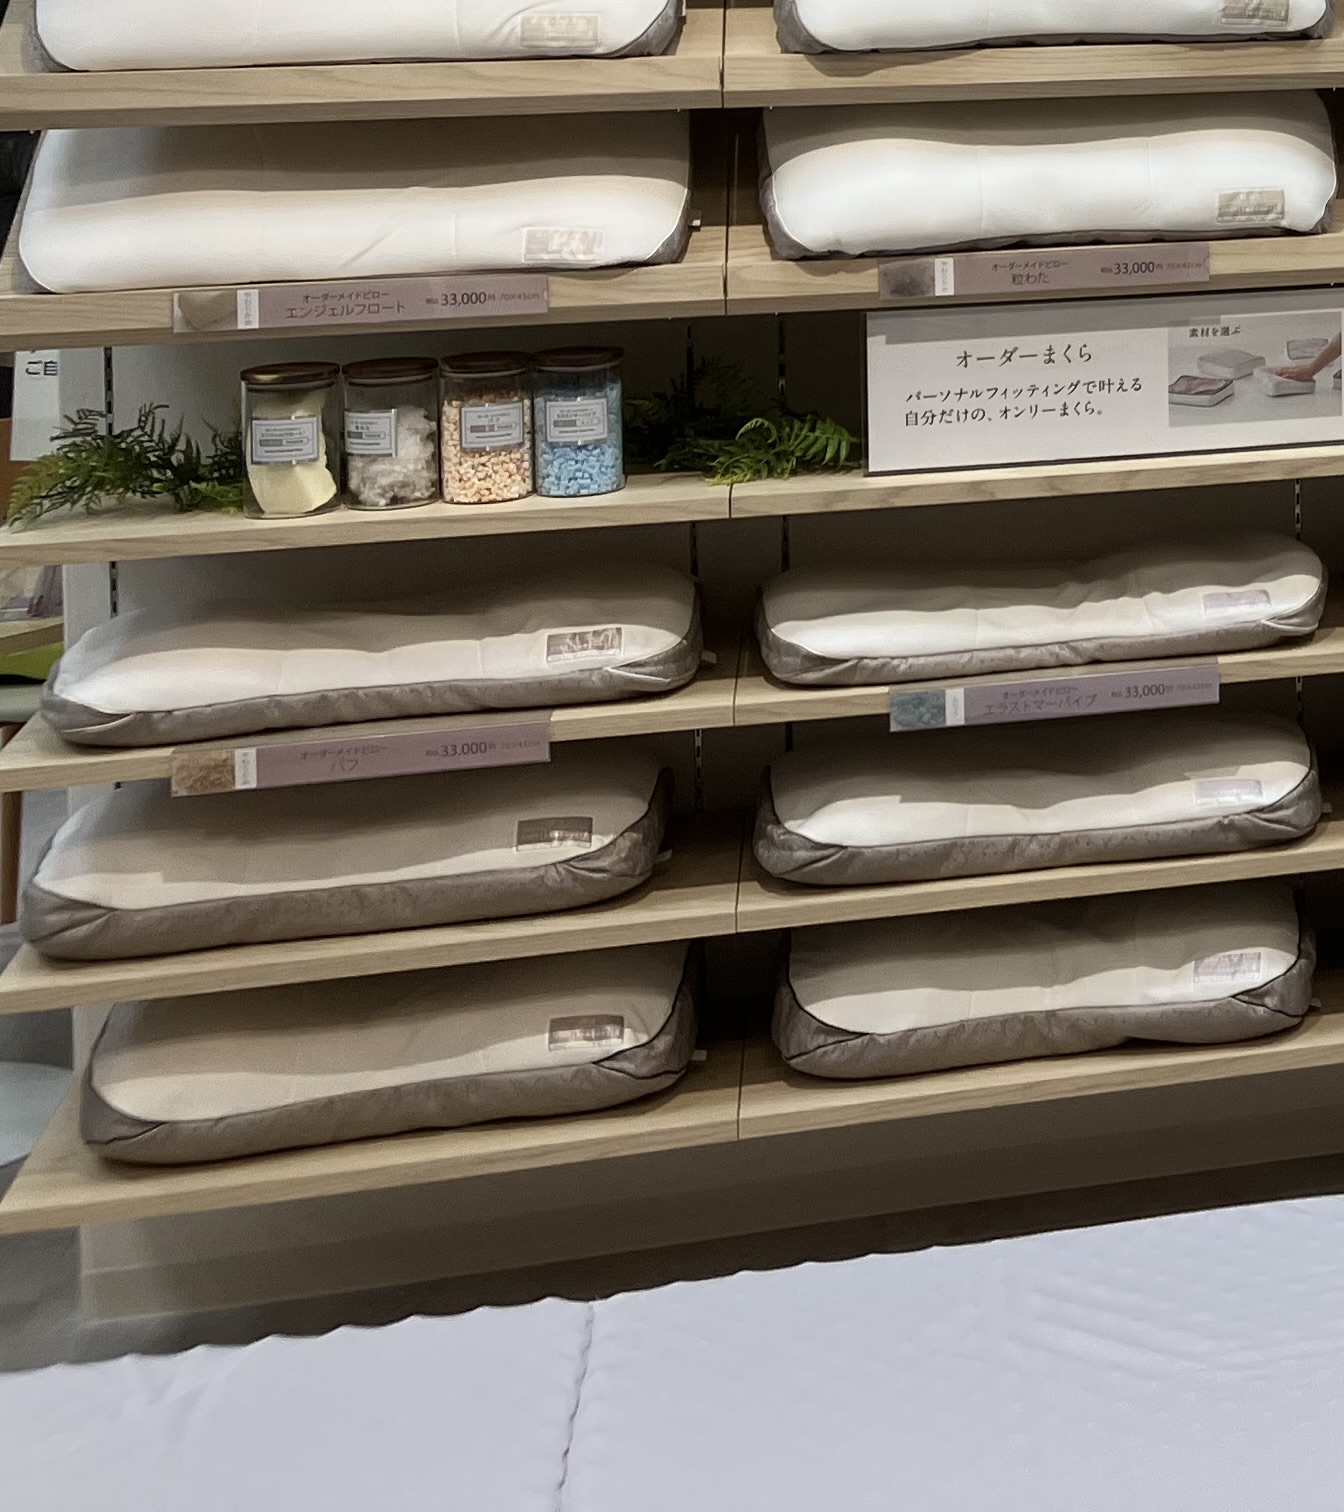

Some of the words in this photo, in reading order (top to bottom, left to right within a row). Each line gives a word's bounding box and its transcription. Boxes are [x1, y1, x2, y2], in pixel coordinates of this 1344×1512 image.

[285, 300, 406, 319] エンジェルフロート
[956, 343, 1094, 369] オーダーまくら
[905, 376, 1143, 404] パーソナルフィッティングで叶える
[904, 403, 1106, 428] 自分だけの、オンリーまくら。
